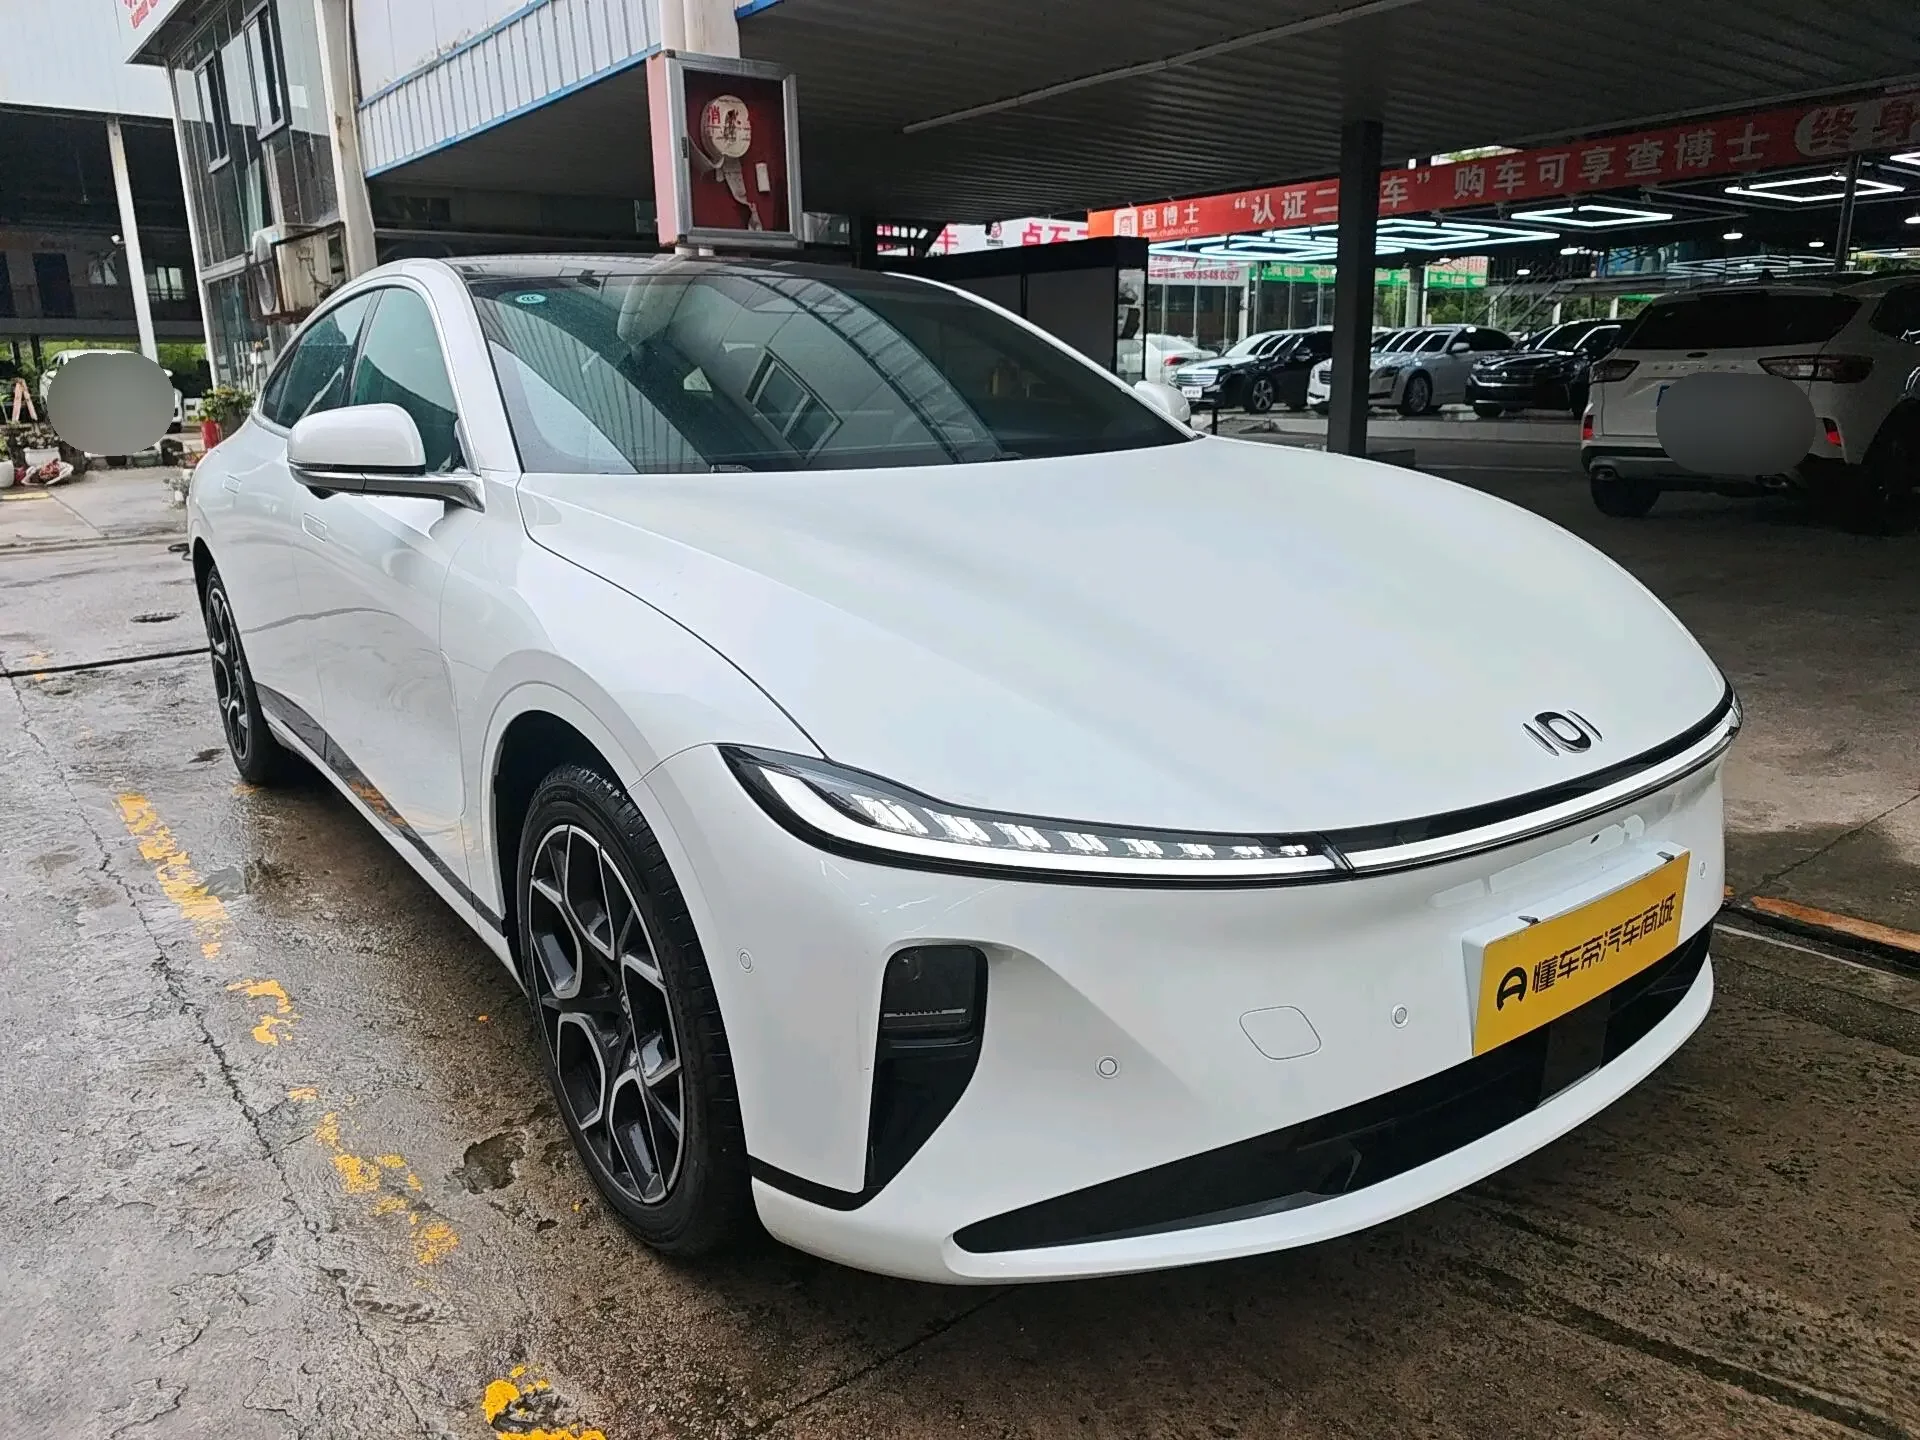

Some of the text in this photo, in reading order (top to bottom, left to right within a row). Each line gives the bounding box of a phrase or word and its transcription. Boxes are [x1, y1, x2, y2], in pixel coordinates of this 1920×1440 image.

[1142, 202, 1199, 230] 查博士
[1531, 892, 1677, 993] 懂车帝汽车商城
